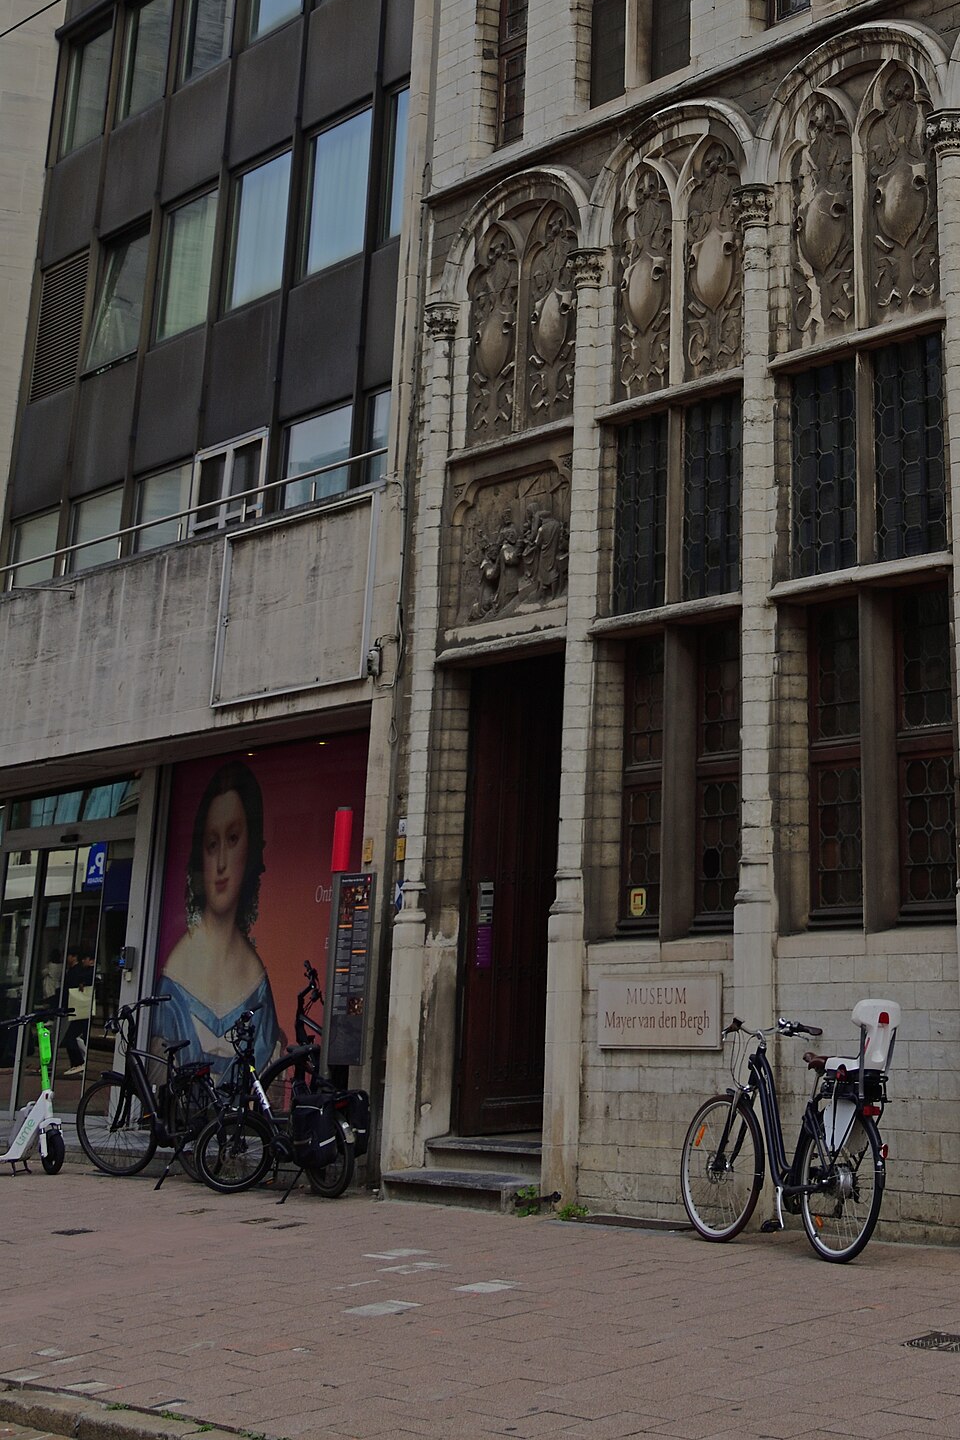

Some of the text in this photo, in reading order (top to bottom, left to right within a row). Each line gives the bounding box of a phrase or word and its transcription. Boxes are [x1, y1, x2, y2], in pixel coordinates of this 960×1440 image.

[626, 987, 687, 1005] MUSEUM
[604, 1010, 710, 1035] Mayer van den Bergh
